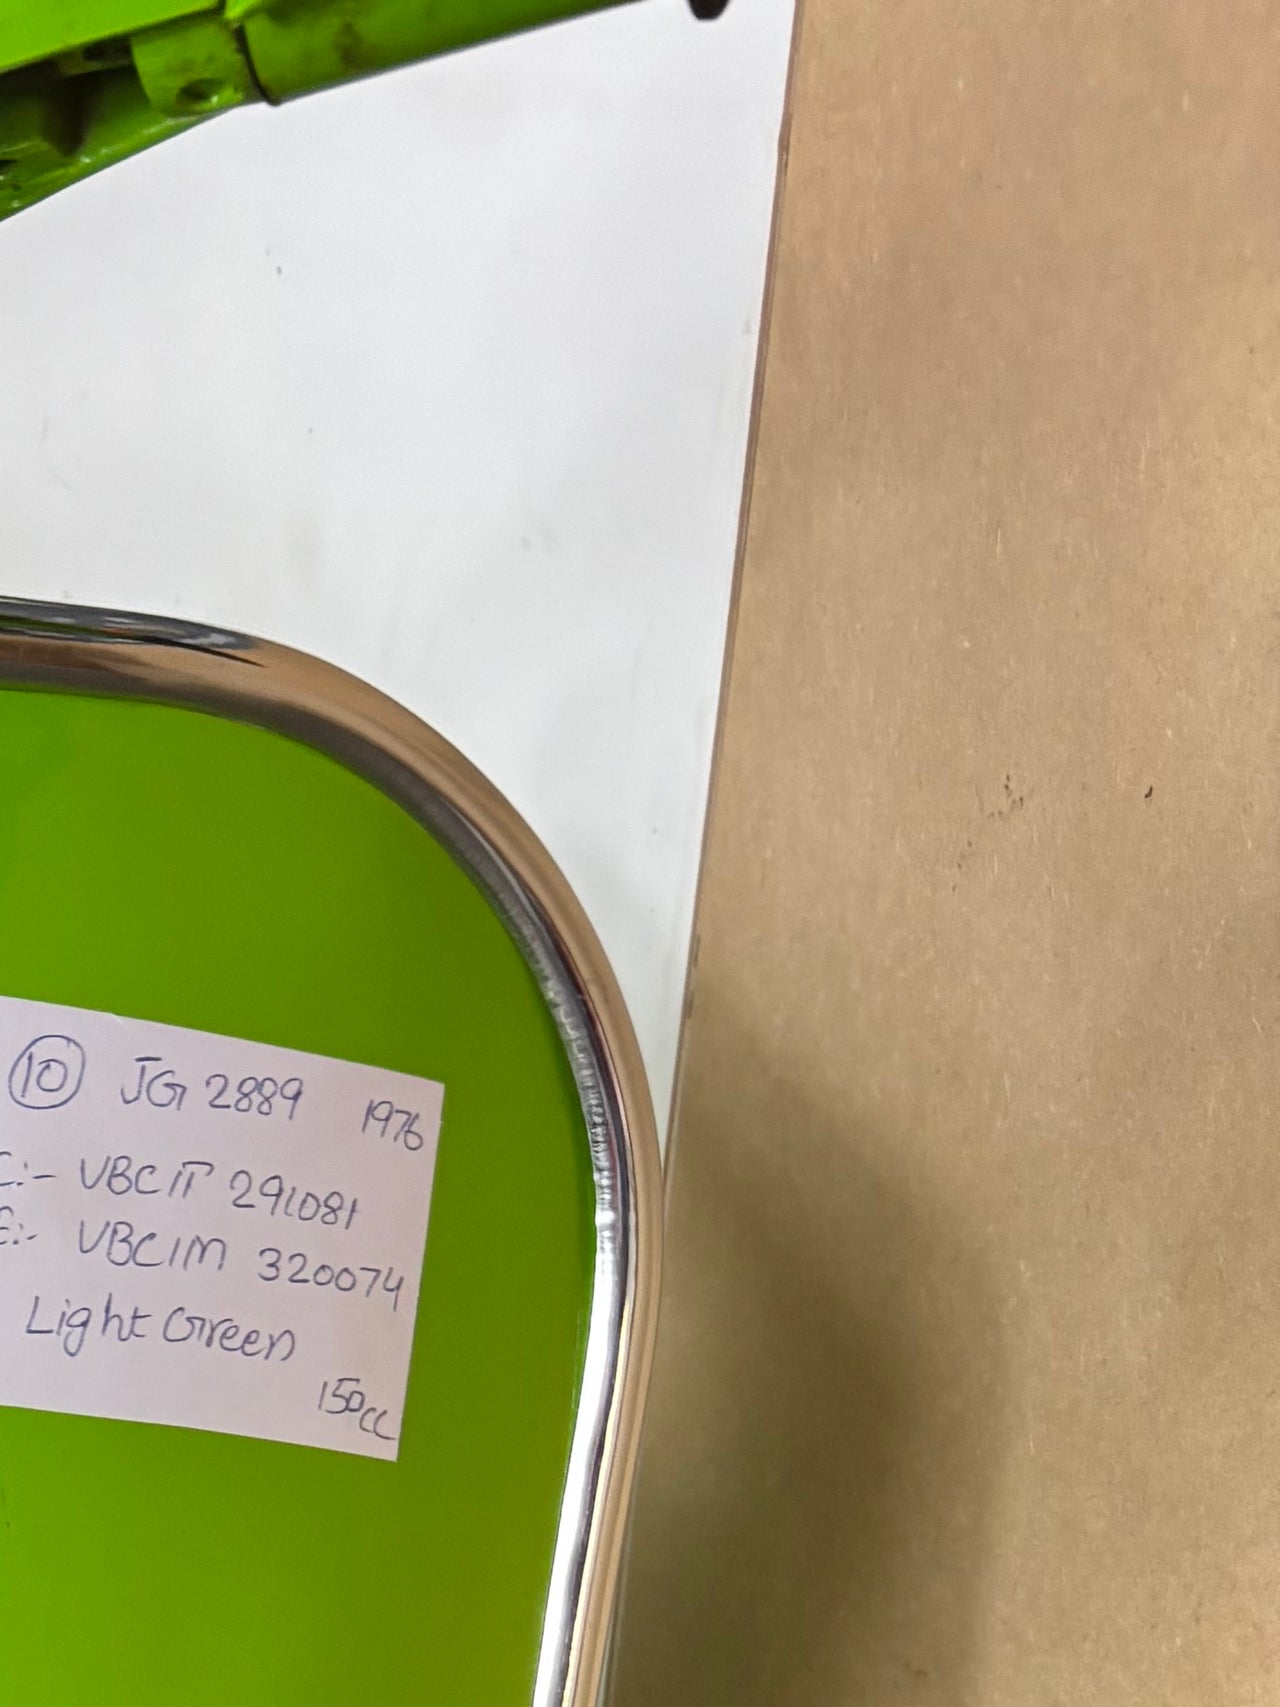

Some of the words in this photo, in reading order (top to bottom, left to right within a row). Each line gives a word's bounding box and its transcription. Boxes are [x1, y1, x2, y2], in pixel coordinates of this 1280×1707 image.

[121, 1056, 187, 1111] JG
[206, 1074, 303, 1120] 2889
[362, 1100, 423, 1151] 1976
[230, 1170, 357, 1229] 291081
[258, 1248, 404, 1312] 320074
[26, 1293, 152, 1357] Light
[163, 1307, 295, 1361] Green
[318, 1378, 393, 1440] 150cc
